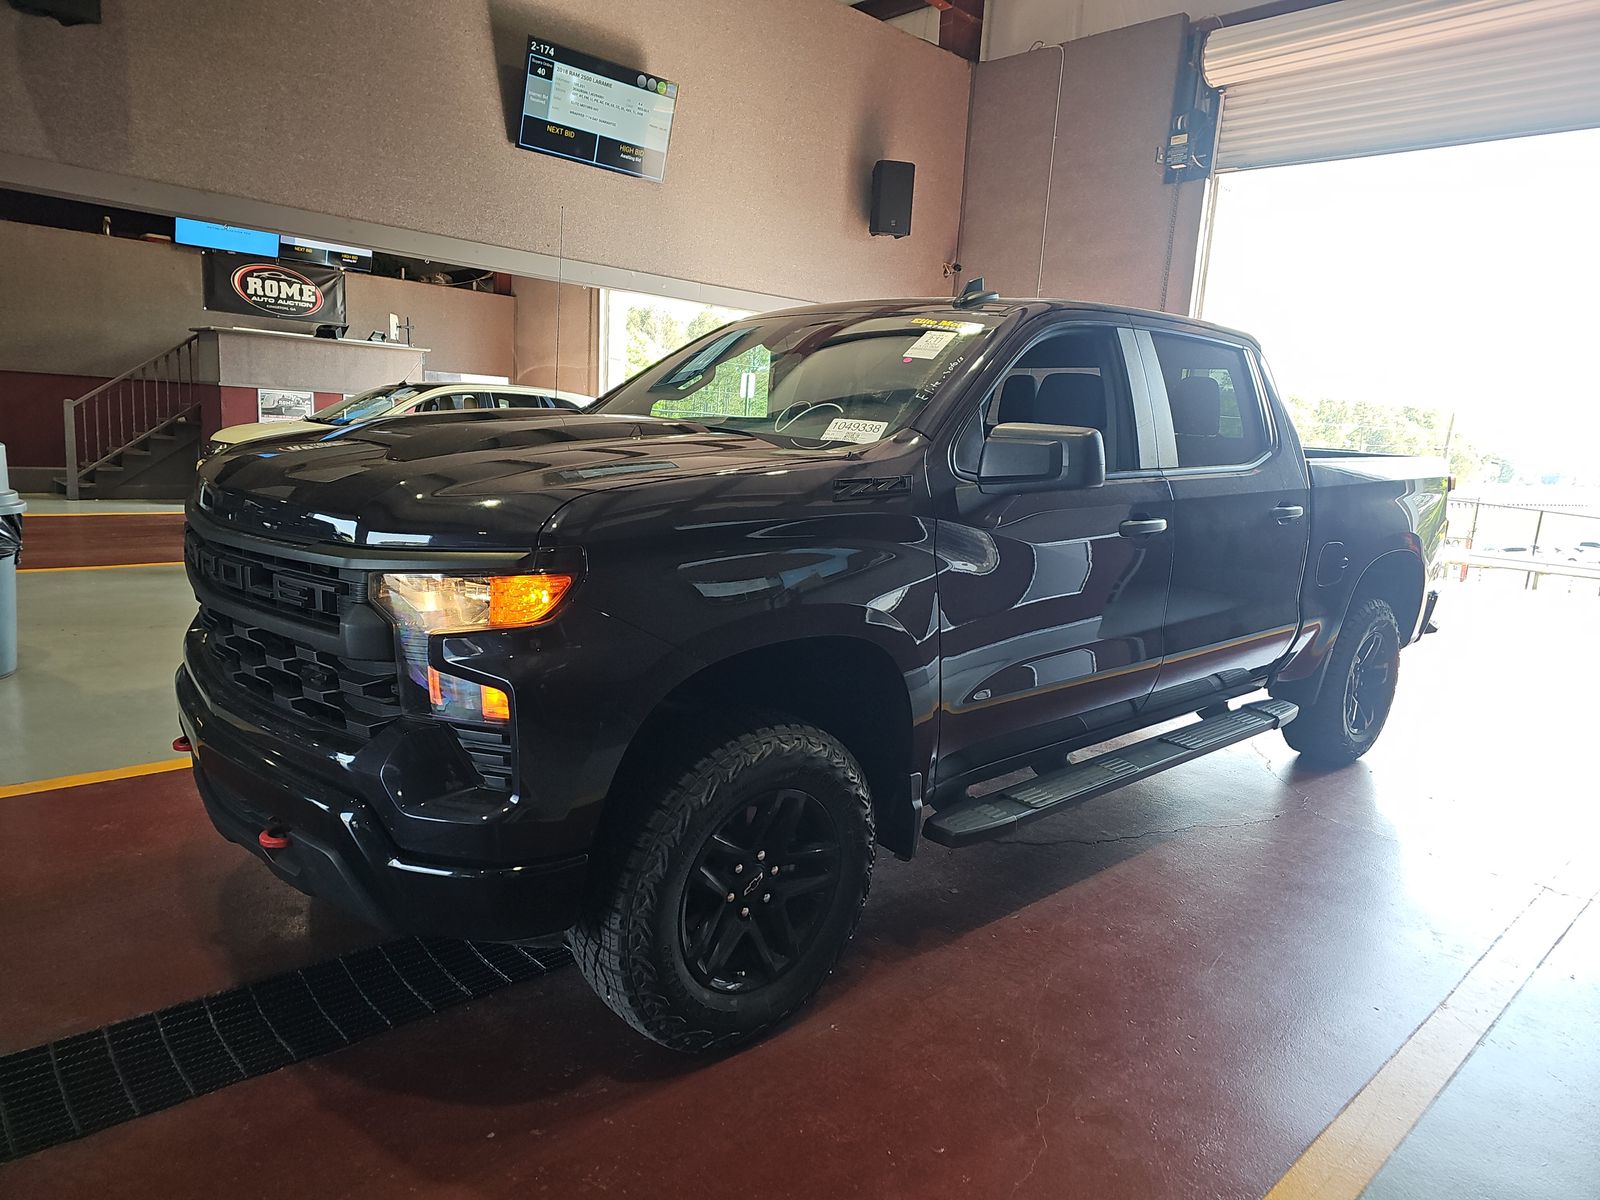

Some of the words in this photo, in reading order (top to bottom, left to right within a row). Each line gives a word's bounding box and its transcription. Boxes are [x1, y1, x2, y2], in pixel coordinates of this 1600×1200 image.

[530, 41, 555, 56] 2-174
[536, 67, 546, 76] 40
[568, 70, 580, 78] RAM
[580, 73, 592, 82] 2500
[592, 76, 613, 88] LARAMIE
[546, 125, 563, 136] NEXT
[564, 130, 576, 138] BID
[619, 144, 634, 155] HIGH
[635, 148, 645, 157] BID
[246, 277, 316, 303] ROME
[252, 296, 275, 304] AUTO
[277, 299, 313, 308] AUCTION
[832, 422, 882, 434] 1049338
